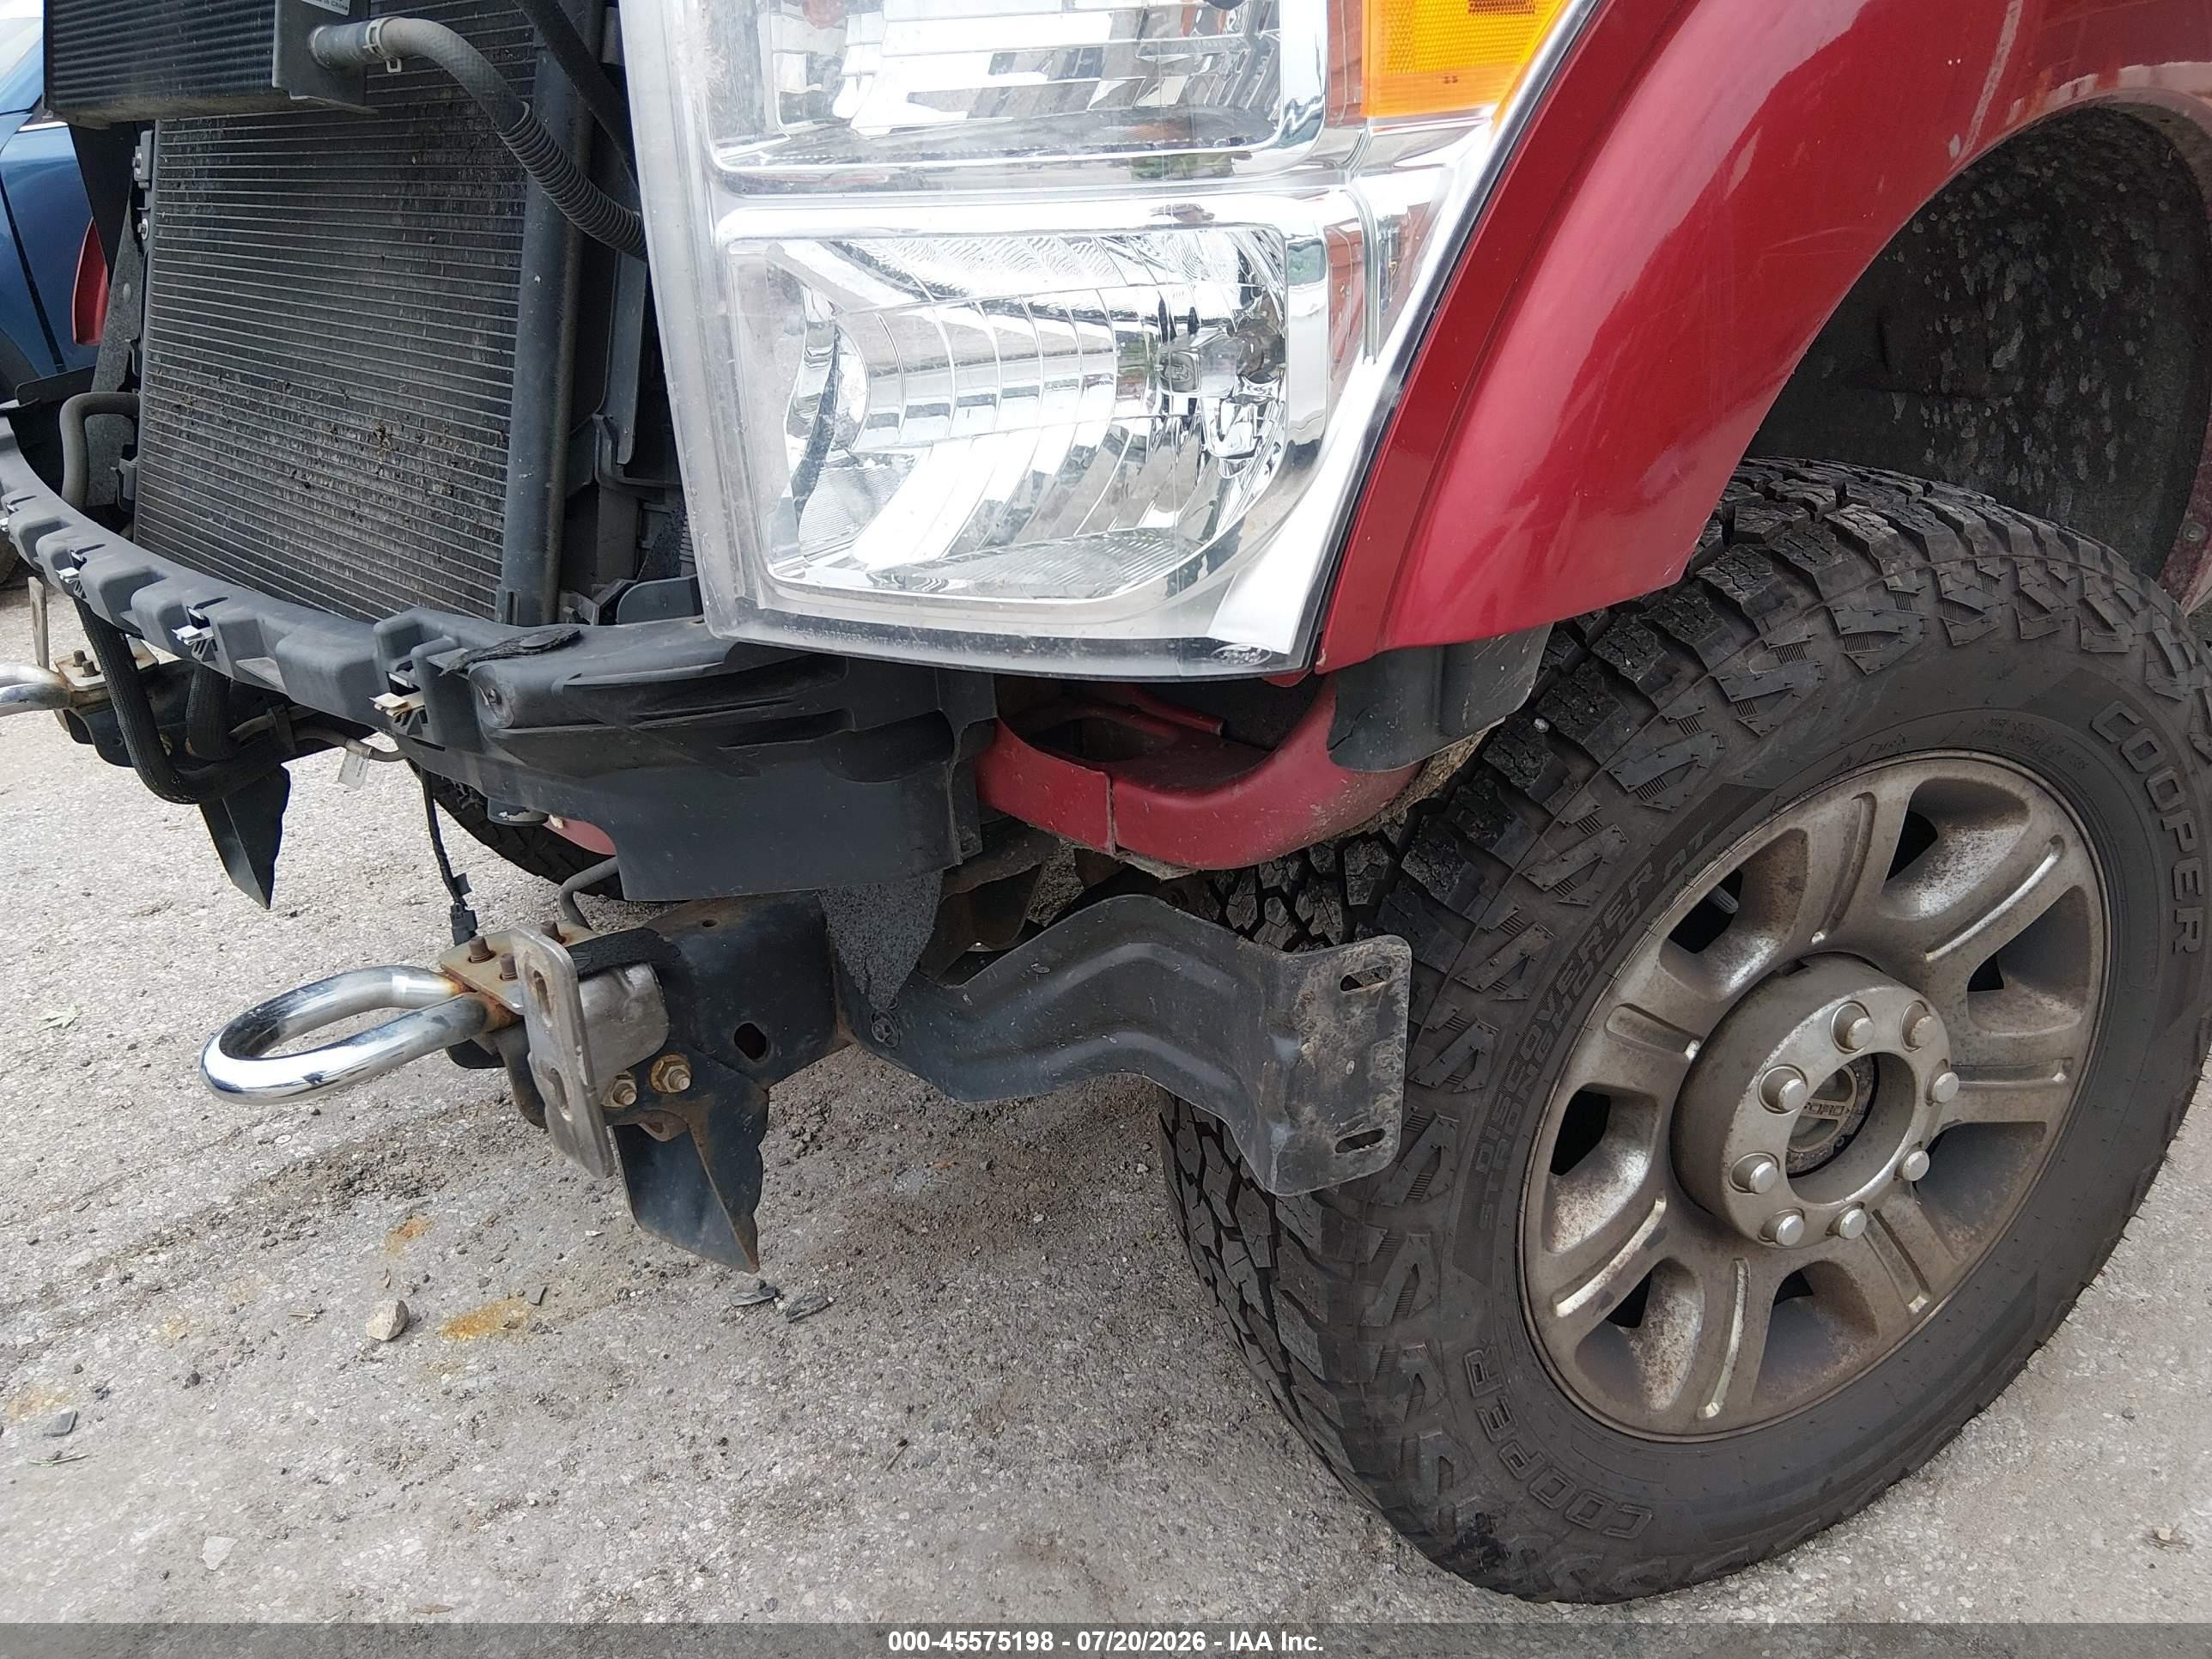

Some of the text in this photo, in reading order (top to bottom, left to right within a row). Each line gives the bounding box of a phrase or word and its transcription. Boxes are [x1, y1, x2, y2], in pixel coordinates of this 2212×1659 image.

[2090, 700, 2204, 955] COOPER
[1474, 861, 1654, 1175] DISCOVERER
[1463, 1338, 1654, 1540] COOPER
